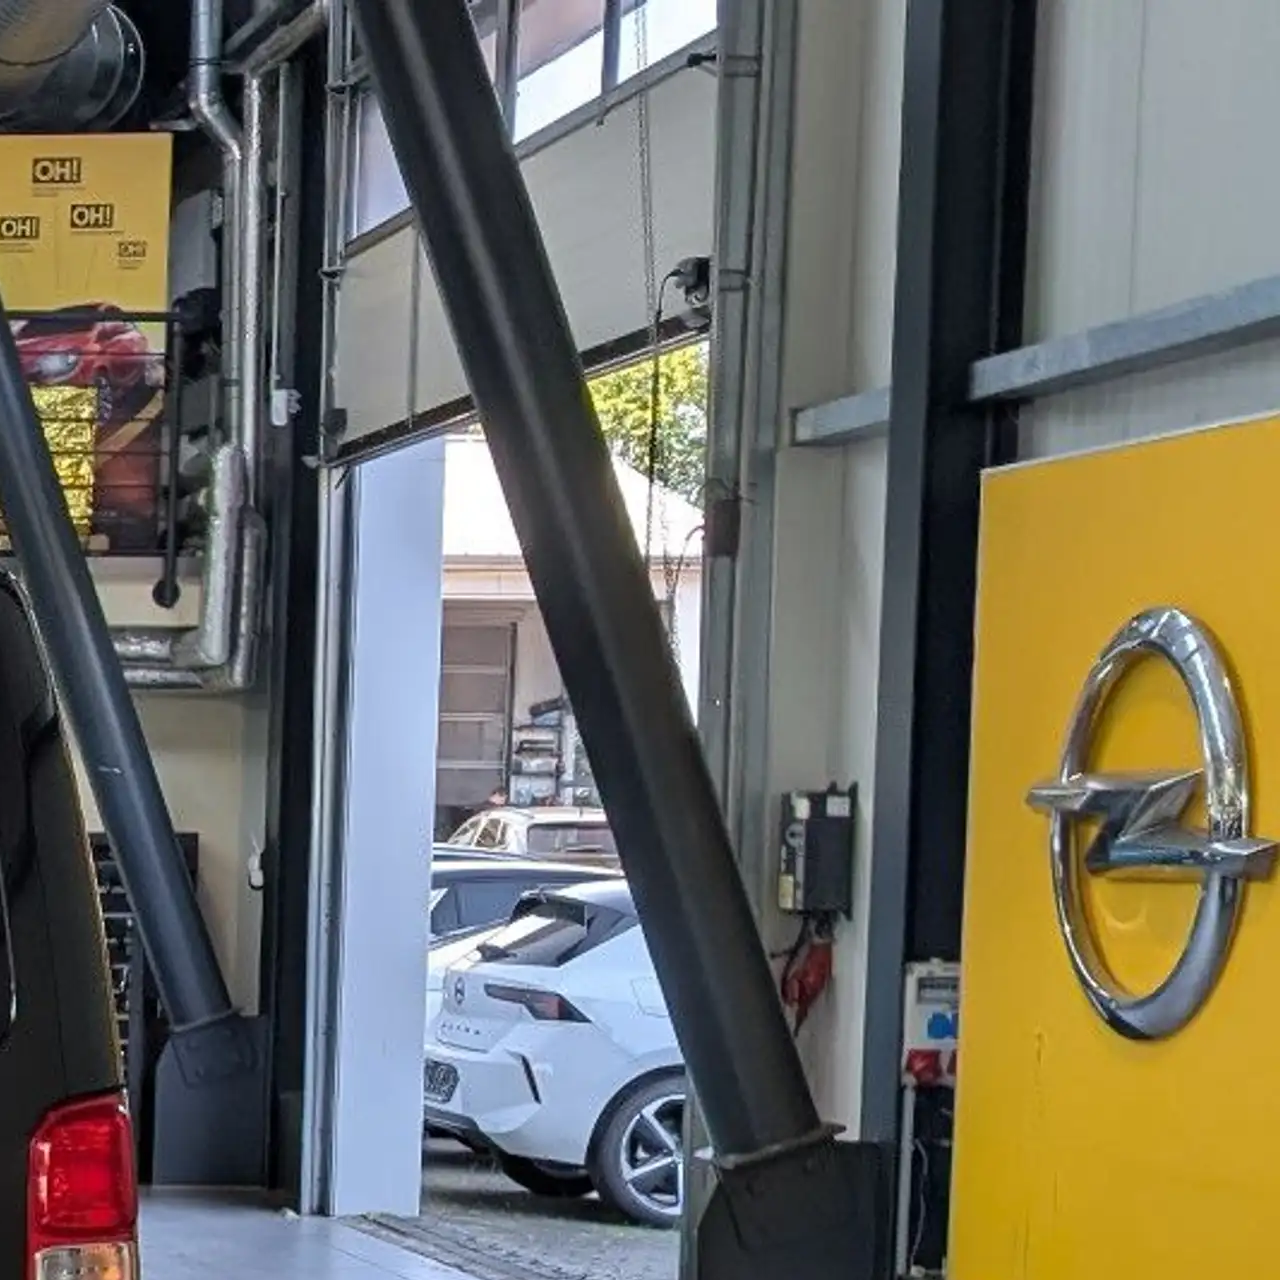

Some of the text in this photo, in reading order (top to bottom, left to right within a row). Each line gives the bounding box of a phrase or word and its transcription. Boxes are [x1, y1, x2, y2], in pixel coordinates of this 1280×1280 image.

[34, 159, 80, 182] OH!
[72, 206, 111, 226] OH!
[0, 218, 38, 237] OH!
